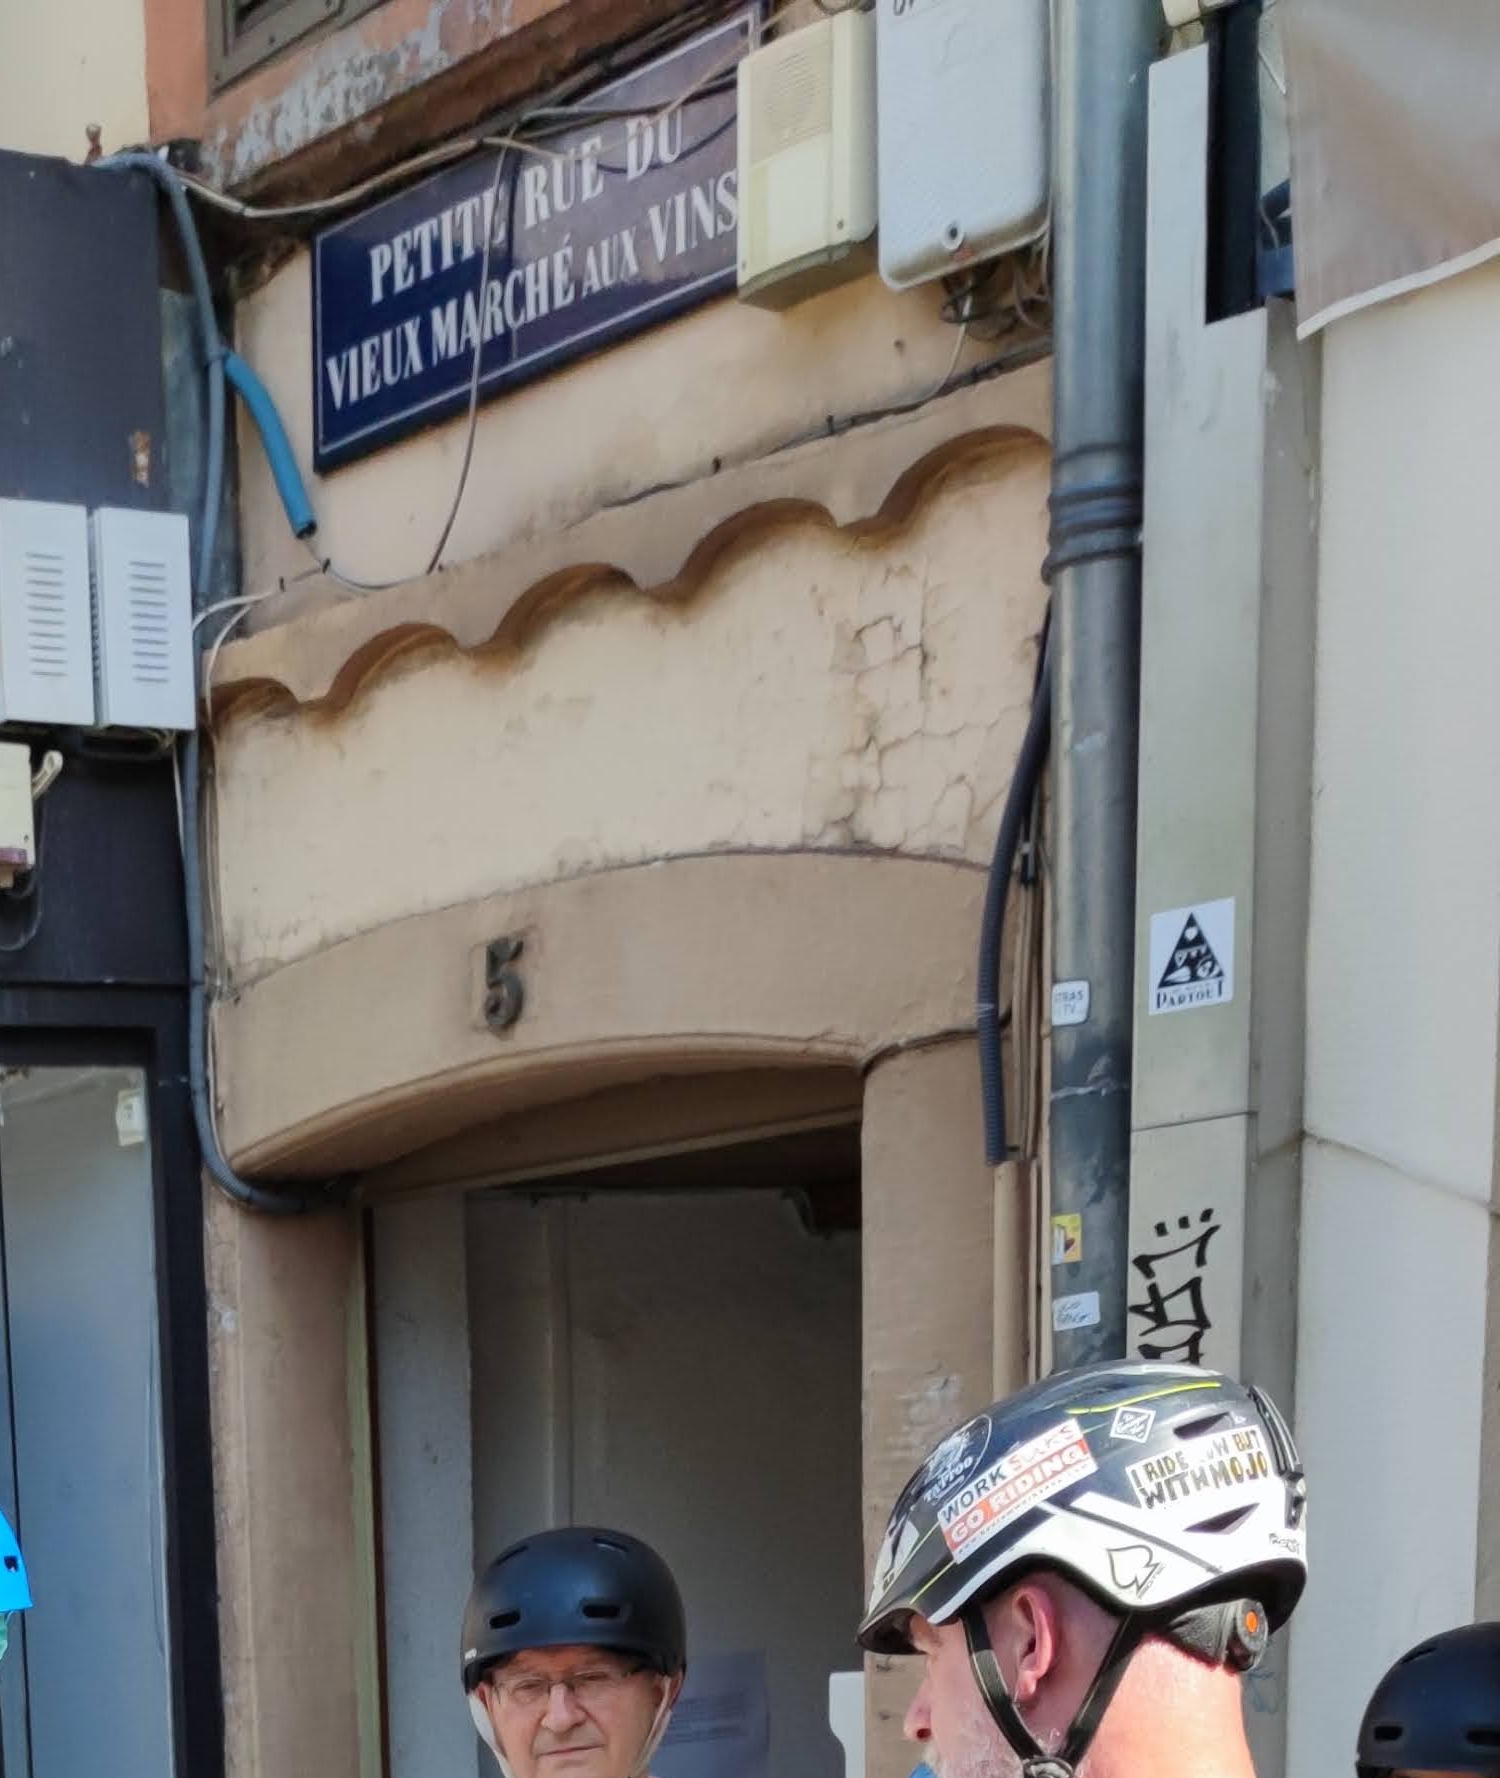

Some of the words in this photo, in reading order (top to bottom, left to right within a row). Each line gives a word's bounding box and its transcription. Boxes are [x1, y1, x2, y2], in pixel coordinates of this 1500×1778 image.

[368, 186, 506, 305] PETITE
[522, 135, 604, 230] RUE
[625, 108, 683, 181] DU
[324, 328, 423, 412] VIEUX
[430, 233, 575, 366] MARCHÉ
[581, 228, 639, 298] AUX
[647, 170, 738, 264] VINS
[484, 936, 525, 1031] 5
[941, 1463, 1007, 1524] WORK
[951, 1509, 986, 1544] GO
[988, 1446, 1086, 1509] RIDING
[1130, 1468, 1142, 1489] I
[1142, 1450, 1190, 1483] RIDE
[1232, 1429, 1263, 1452] BUT
[1138, 1467, 1211, 1510] WITH
[1209, 1450, 1269, 1489] MOJO
